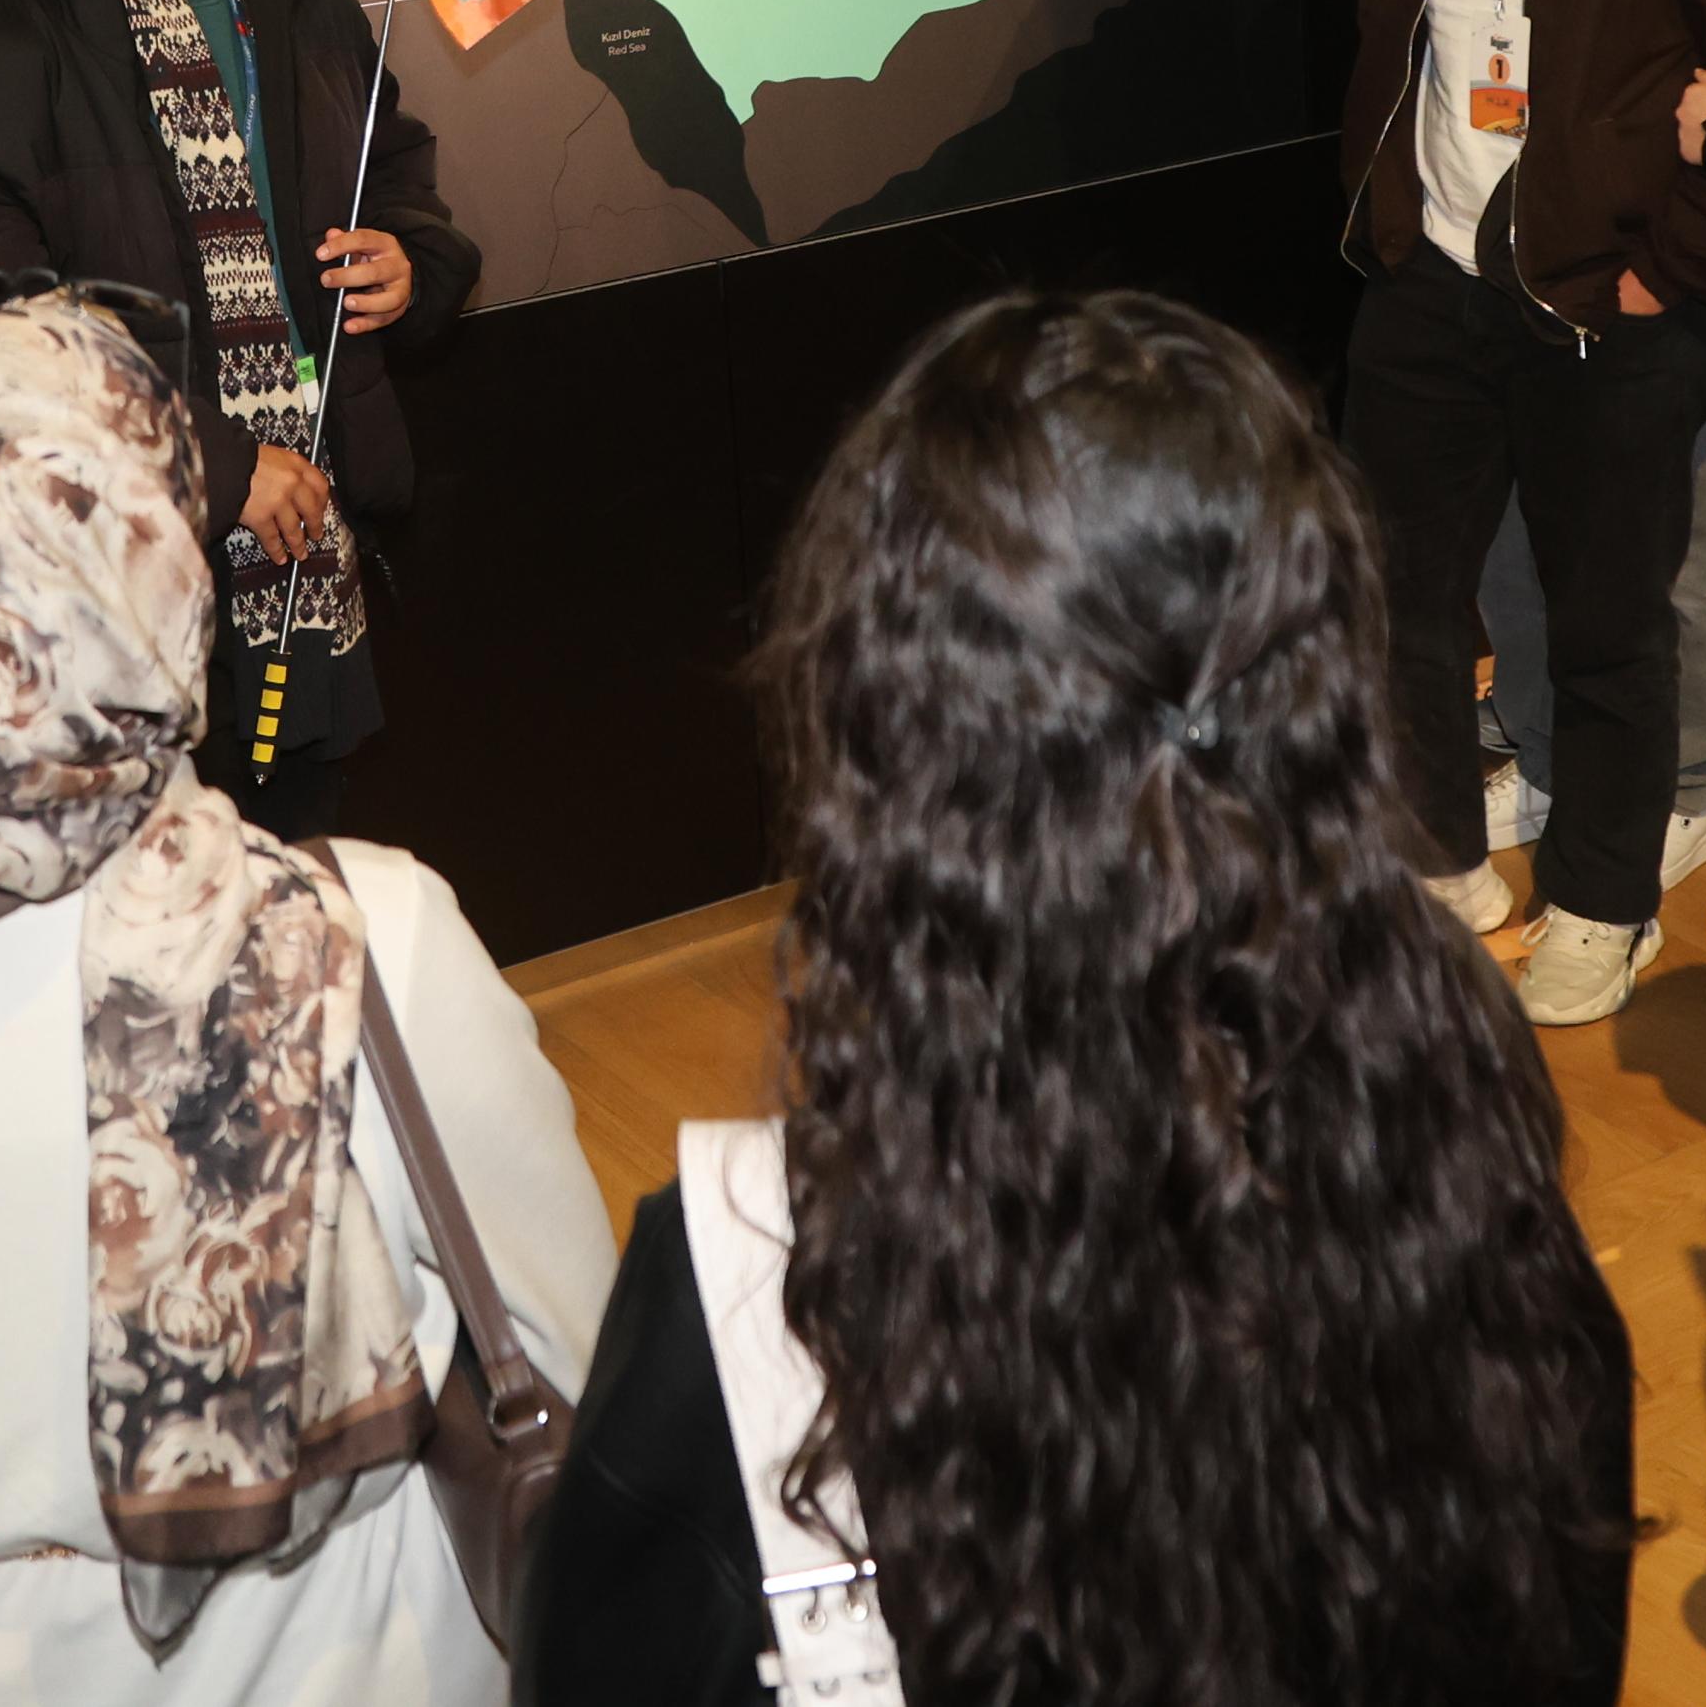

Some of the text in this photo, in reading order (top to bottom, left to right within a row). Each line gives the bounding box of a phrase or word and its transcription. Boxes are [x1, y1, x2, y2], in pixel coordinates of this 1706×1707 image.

[601, 27, 651, 43] Kızıl Deniz
[608, 43, 646, 56] Red Sea
[1496, 58, 1504, 79] 1
